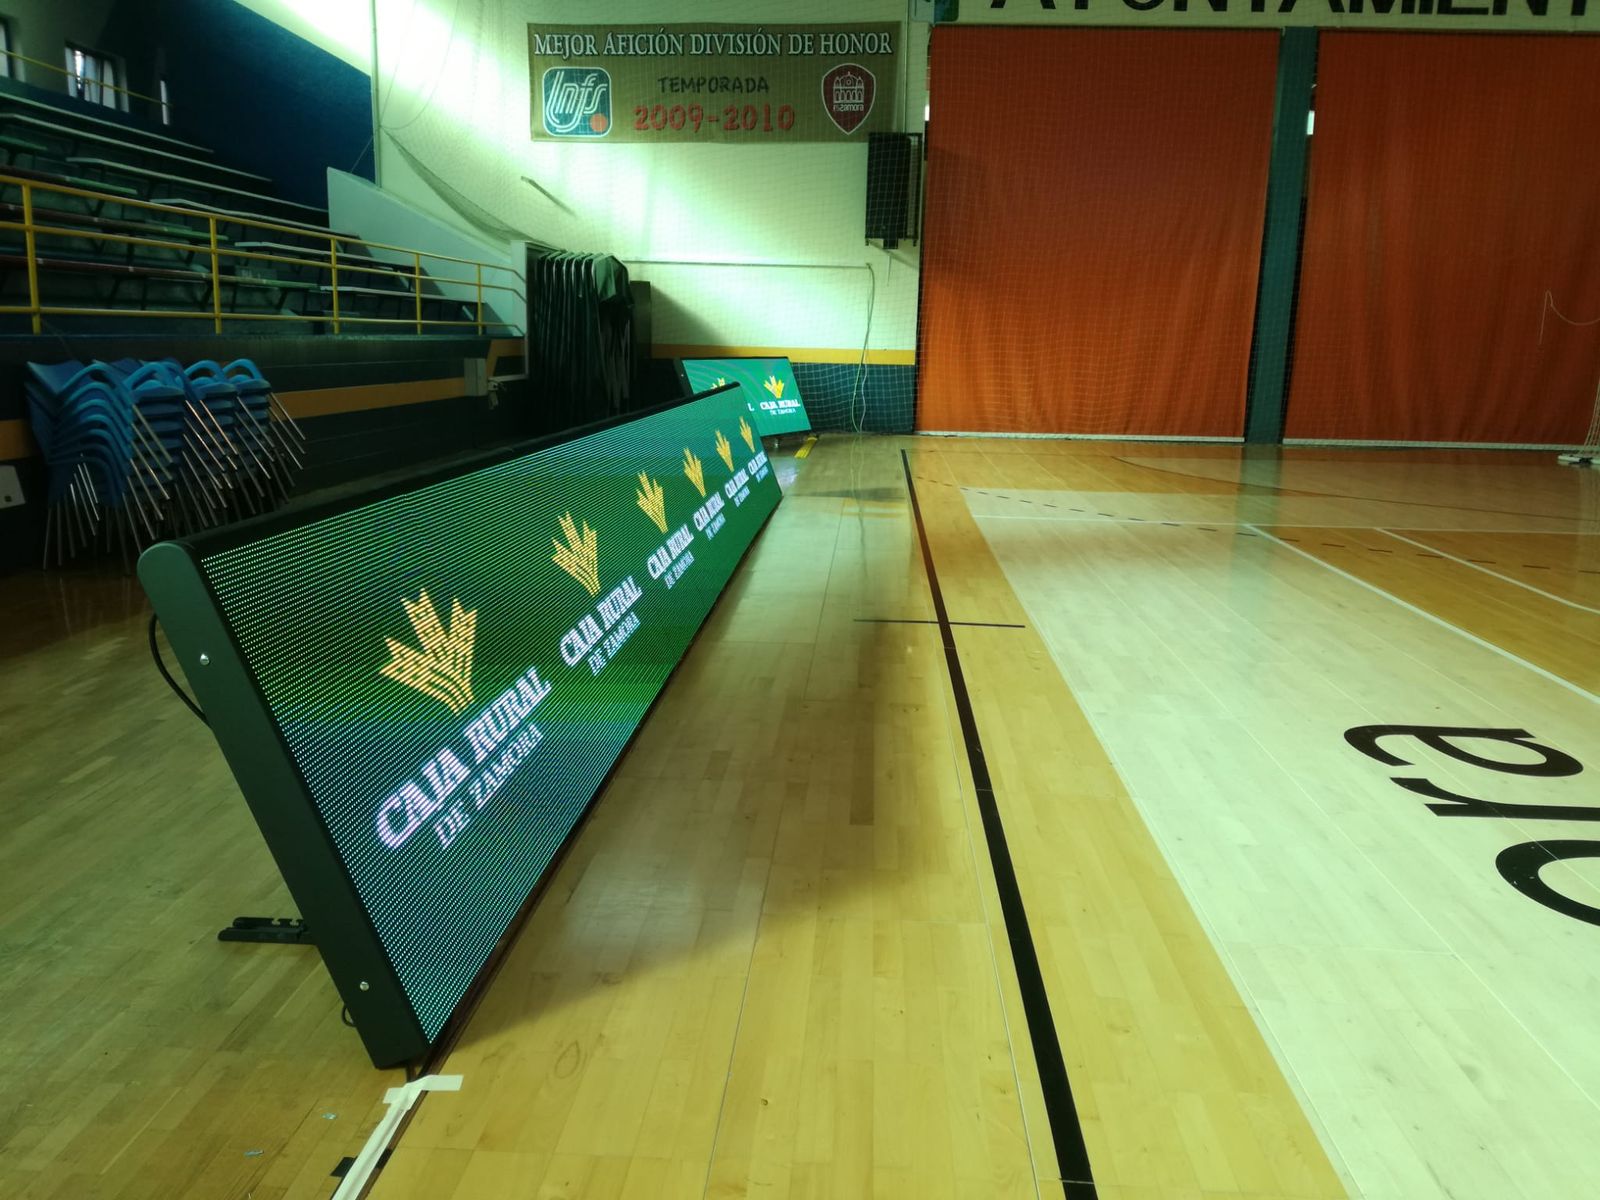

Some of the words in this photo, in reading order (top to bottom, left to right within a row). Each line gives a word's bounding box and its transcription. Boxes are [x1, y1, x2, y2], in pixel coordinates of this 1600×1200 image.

[534, 33, 598, 60] MEJOR
[603, 27, 684, 55] AFICIÓN
[690, 27, 782, 55] DIVISIÓN
[788, 33, 814, 54] DE
[819, 32, 892, 54] HONOR
[658, 76, 769, 93] TEMPORADA
[634, 103, 795, 133] 2009-2010
[647, 545, 672, 580] CAJA
[560, 614, 604, 667] CAJA
[596, 576, 643, 631] RURAL
[376, 748, 471, 849] CAJA
[463, 666, 552, 764] RURAL
[433, 799, 470, 849] DE
[469, 723, 543, 811] ZAMORA
